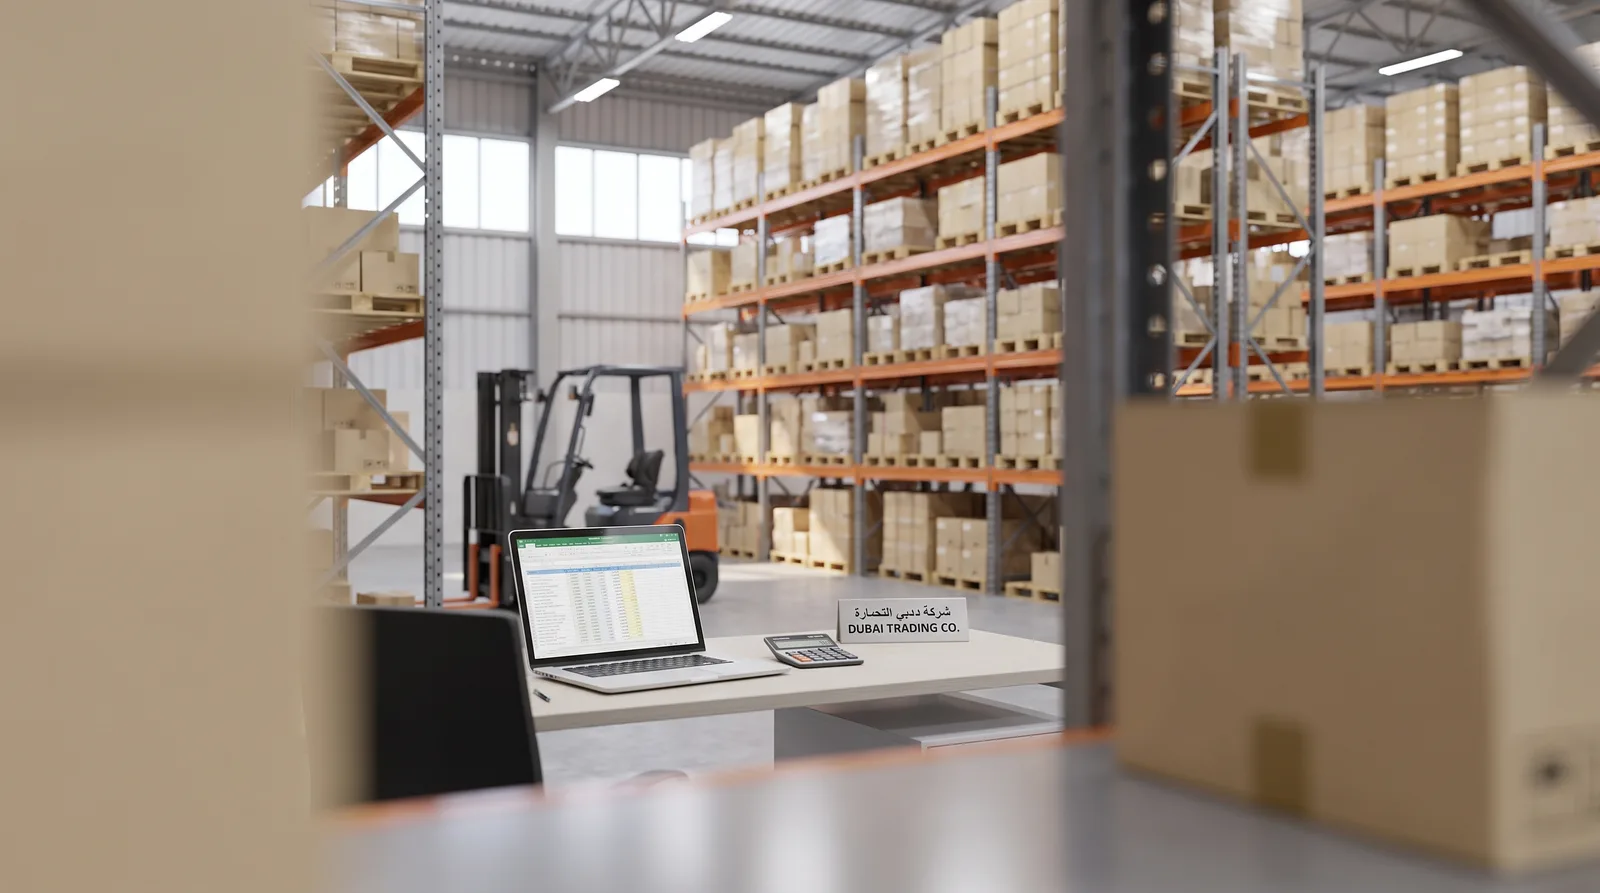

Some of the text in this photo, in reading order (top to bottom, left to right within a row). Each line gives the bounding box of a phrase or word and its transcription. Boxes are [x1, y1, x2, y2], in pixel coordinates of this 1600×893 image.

[923, 605, 951, 619] شركة
[848, 623, 960, 634] DUBAI TRADING CO.
